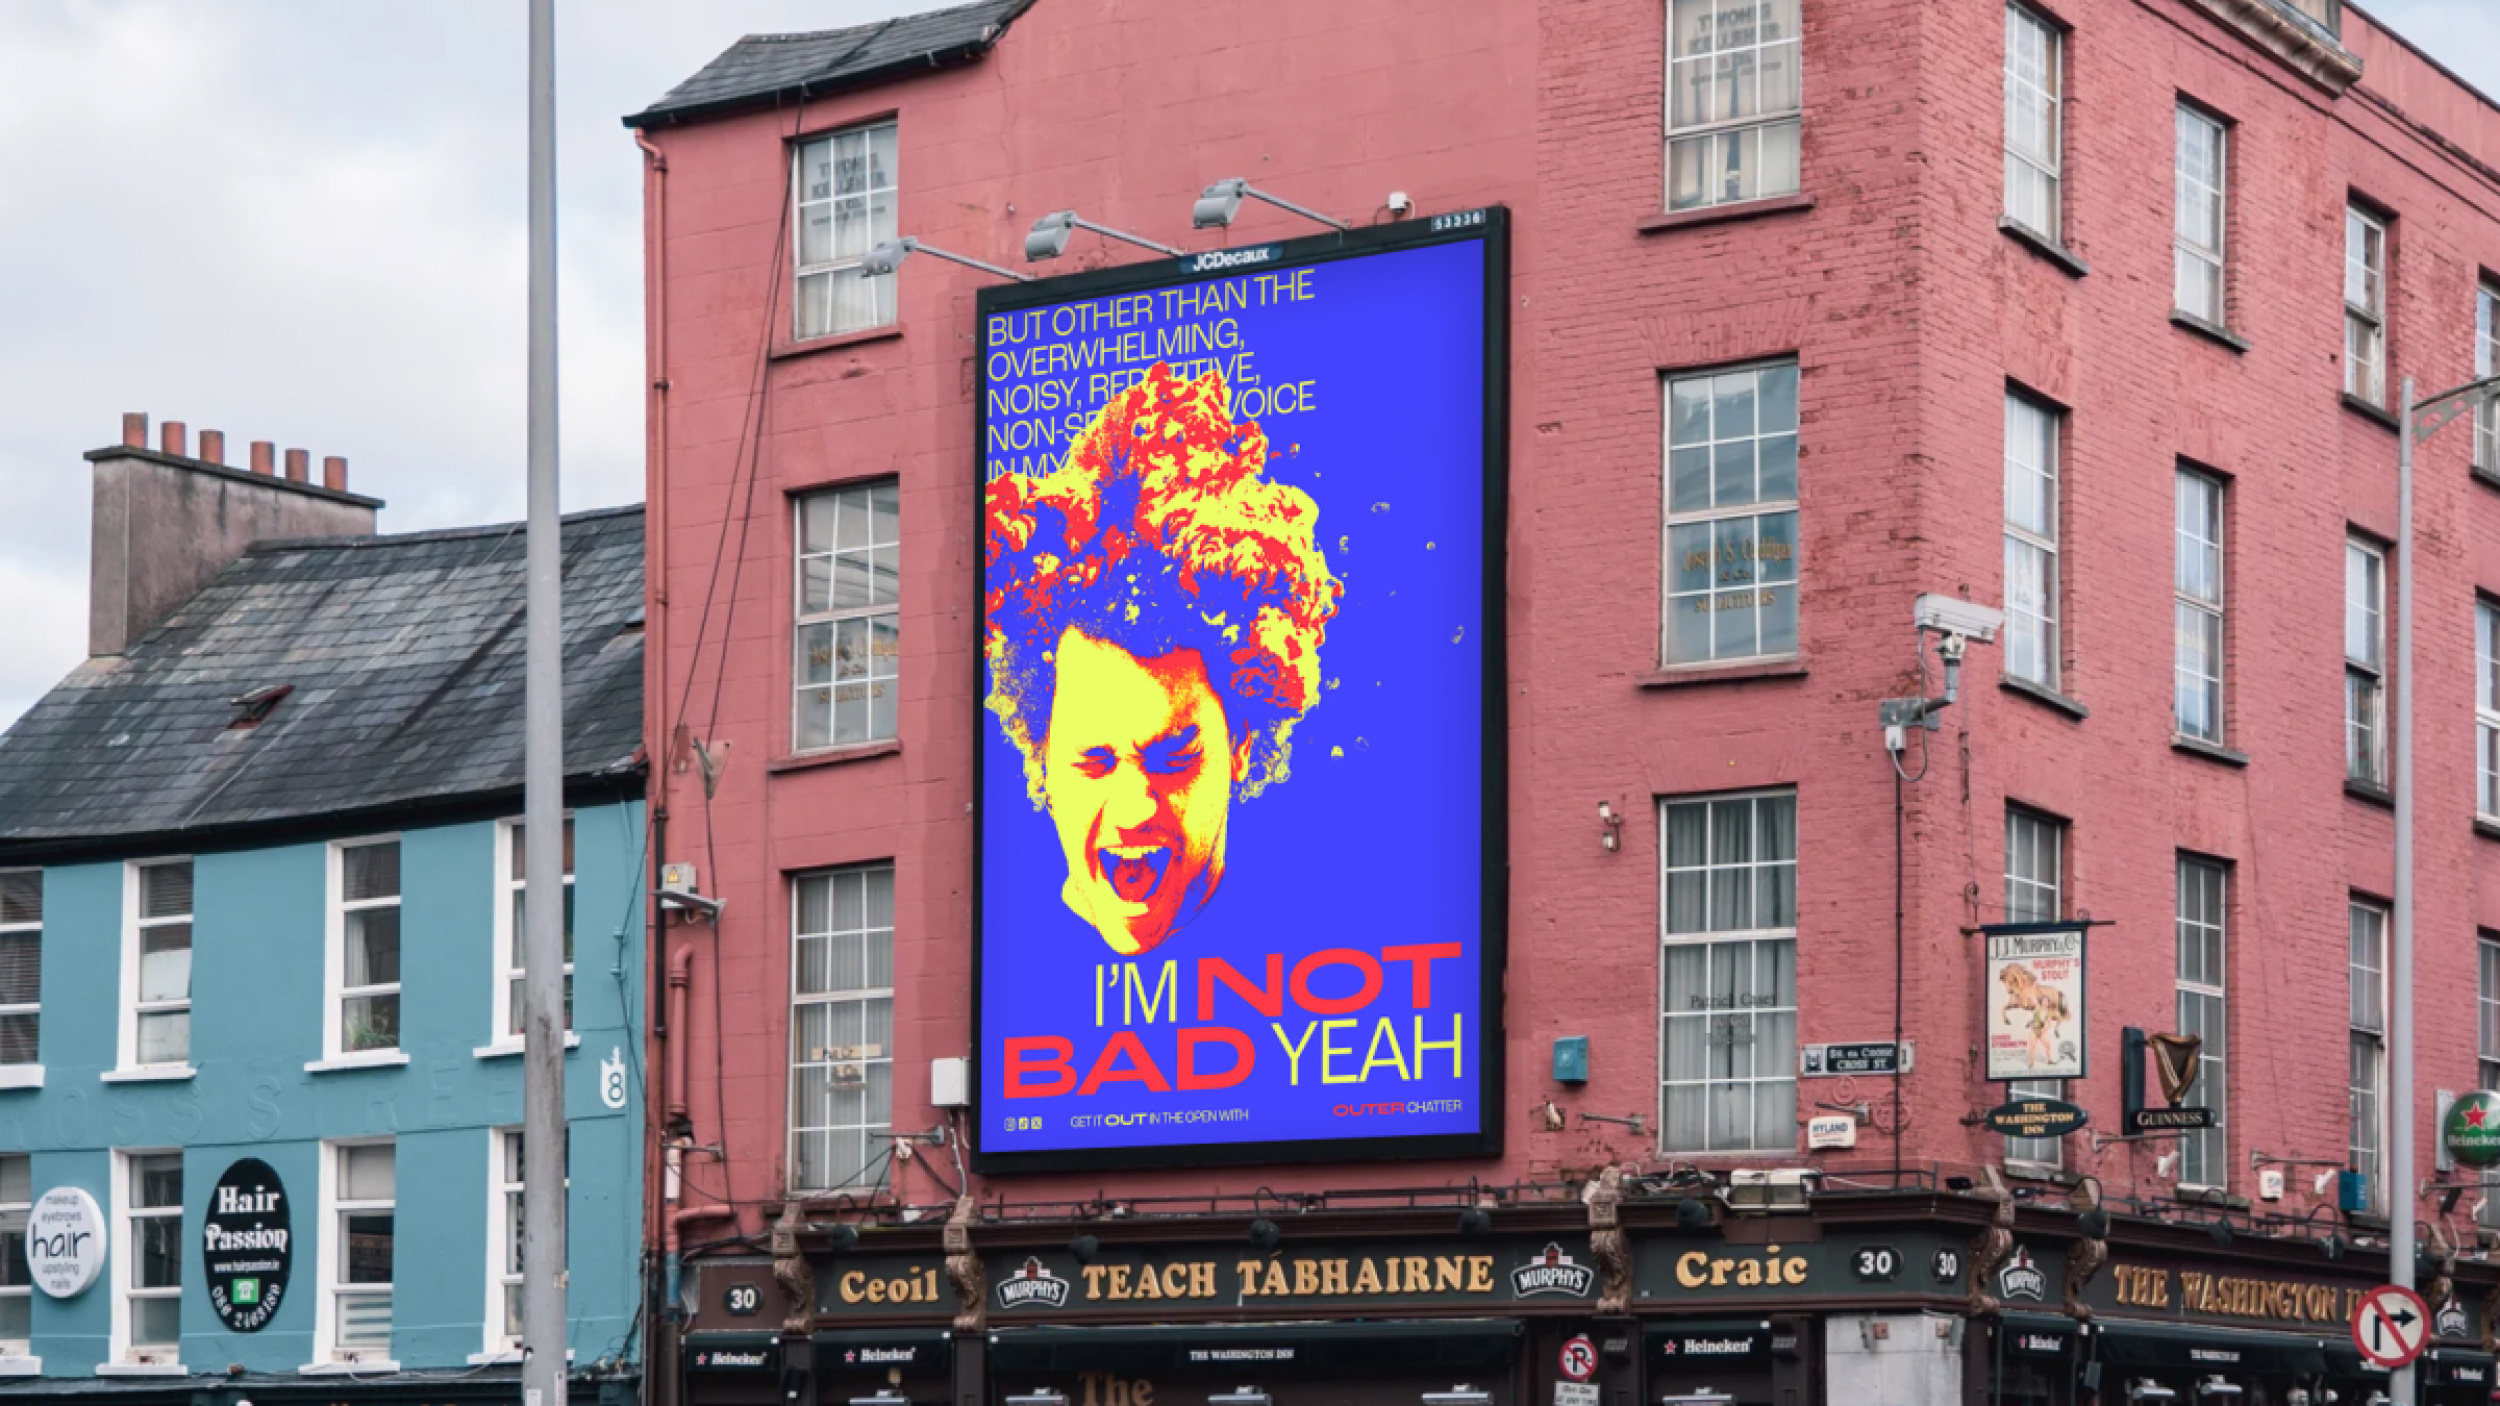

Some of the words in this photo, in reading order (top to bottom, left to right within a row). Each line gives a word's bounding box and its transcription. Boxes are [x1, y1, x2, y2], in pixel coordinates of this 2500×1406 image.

[1193, 247, 1270, 272] JCDecaux
[988, 310, 1047, 347] BUT
[1052, 295, 1153, 337] OTHER
[1159, 278, 1248, 320] THAN
[1253, 268, 1316, 305] THE
[987, 319, 1245, 382] OVERWHELMING,
[988, 376, 1081, 418] NOISY,
[1089, 351, 1262, 404] REPTITIVE,
[1228, 379, 1316, 420] VOICE
[1095, 959, 1178, 1027] I'M
[1197, 941, 1462, 1021] NOT
[1003, 1026, 1256, 1099] BAD
[1270, 1012, 1462, 1086] YEAH
[1070, 1115, 1090, 1129] GET
[1091, 1115, 1102, 1128] IT
[1105, 1113, 1148, 1127] OUT
[1149, 1111, 1161, 1126] IN
[1162, 1111, 1184, 1125] THE
[1184, 1109, 1218, 1124] OPEN
[1218, 1107, 1249, 1122] WITH
[1333, 1101, 1405, 1118] OUTER
[1406, 1099, 1463, 1114] CHATTER
[1994, 1112, 2075, 1126] WASHINGTON
[2022, 1102, 2047, 1113] THE
[2137, 1110, 2205, 1127] GUINNESS
[218, 1185, 281, 1214] Hair
[32, 1222, 91, 1259] hair
[205, 1222, 289, 1254] Passion
[1081, 1262, 1218, 1302] TEACH
[1236, 1250, 1496, 1298] TÁBHAIRNE
[1675, 1245, 1808, 1288] Craic
[1858, 1251, 1894, 1275] 30
[1938, 1251, 1958, 1277] 30
[730, 1288, 756, 1310] 30
[839, 1266, 940, 1303] Ceoil
[2113, 1263, 2170, 1309] THE
[2180, 1270, 2338, 1323] WASHINGTON
[860, 1346, 917, 1364] Heineken
[1189, 1350, 1209, 1362] THE
[1683, 1336, 1753, 1354] Heineken
[1078, 1373, 1155, 1406] The
